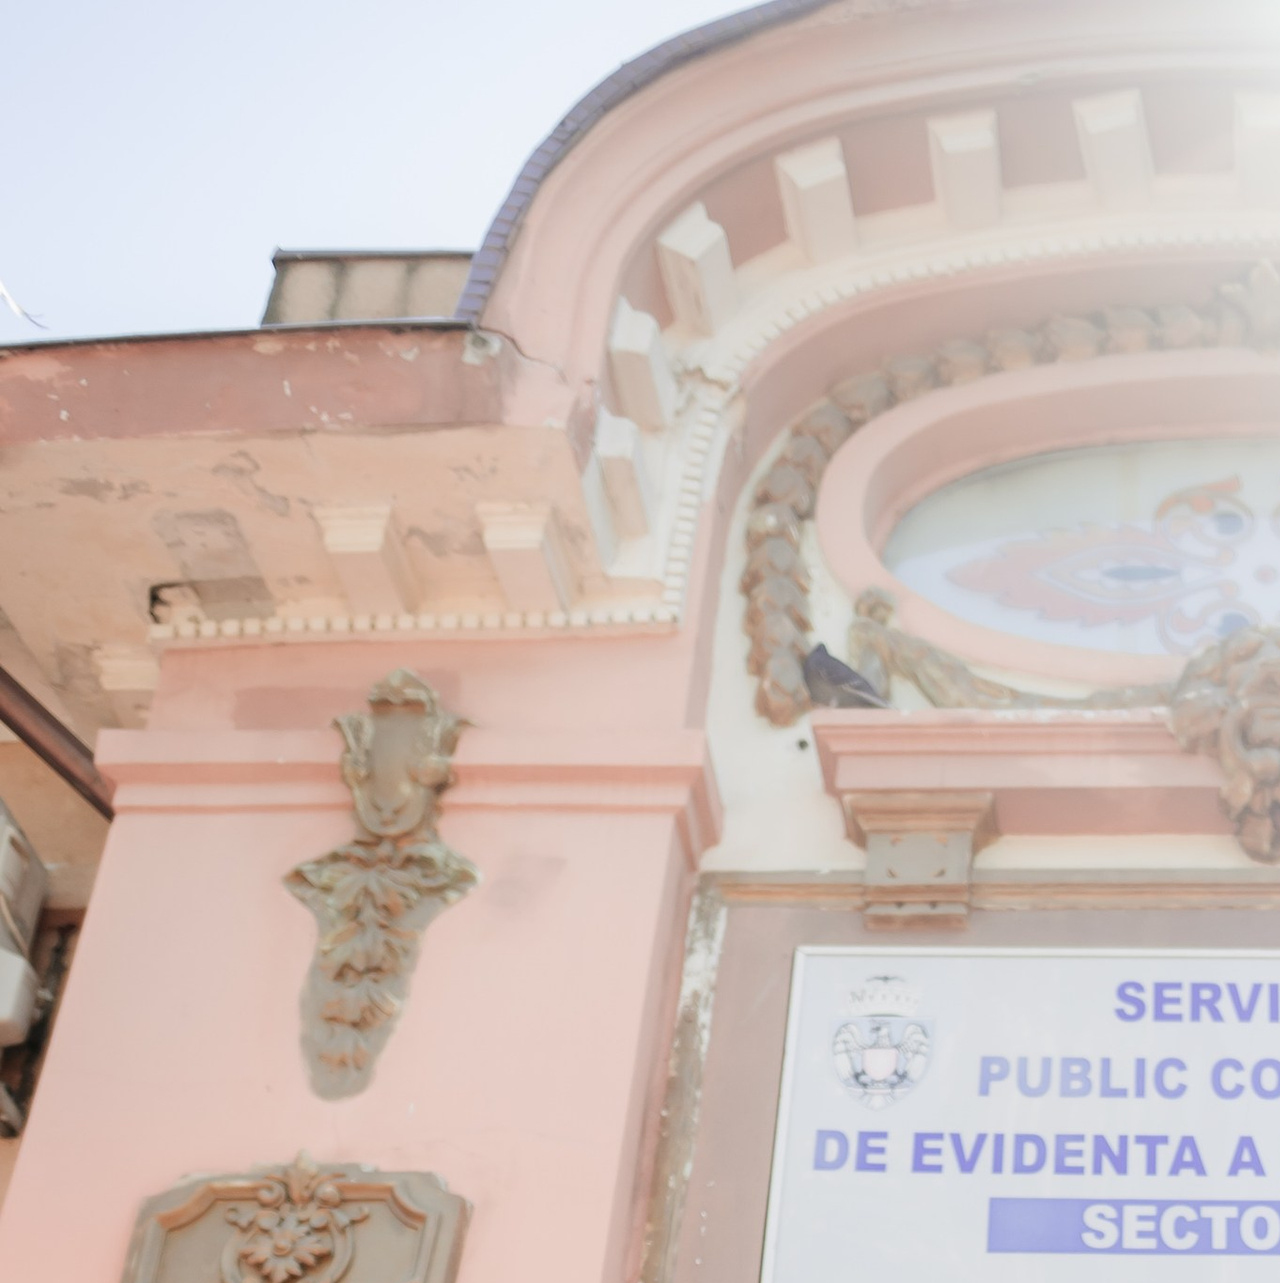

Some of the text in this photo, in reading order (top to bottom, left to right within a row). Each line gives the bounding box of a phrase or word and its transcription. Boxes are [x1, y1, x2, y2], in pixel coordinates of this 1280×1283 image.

[978, 1056, 1188, 1101] PUBLIC
[813, 1130, 889, 1173] DE
[911, 1132, 1209, 1177] EVIDENTA
[1227, 1135, 1268, 1178] A
